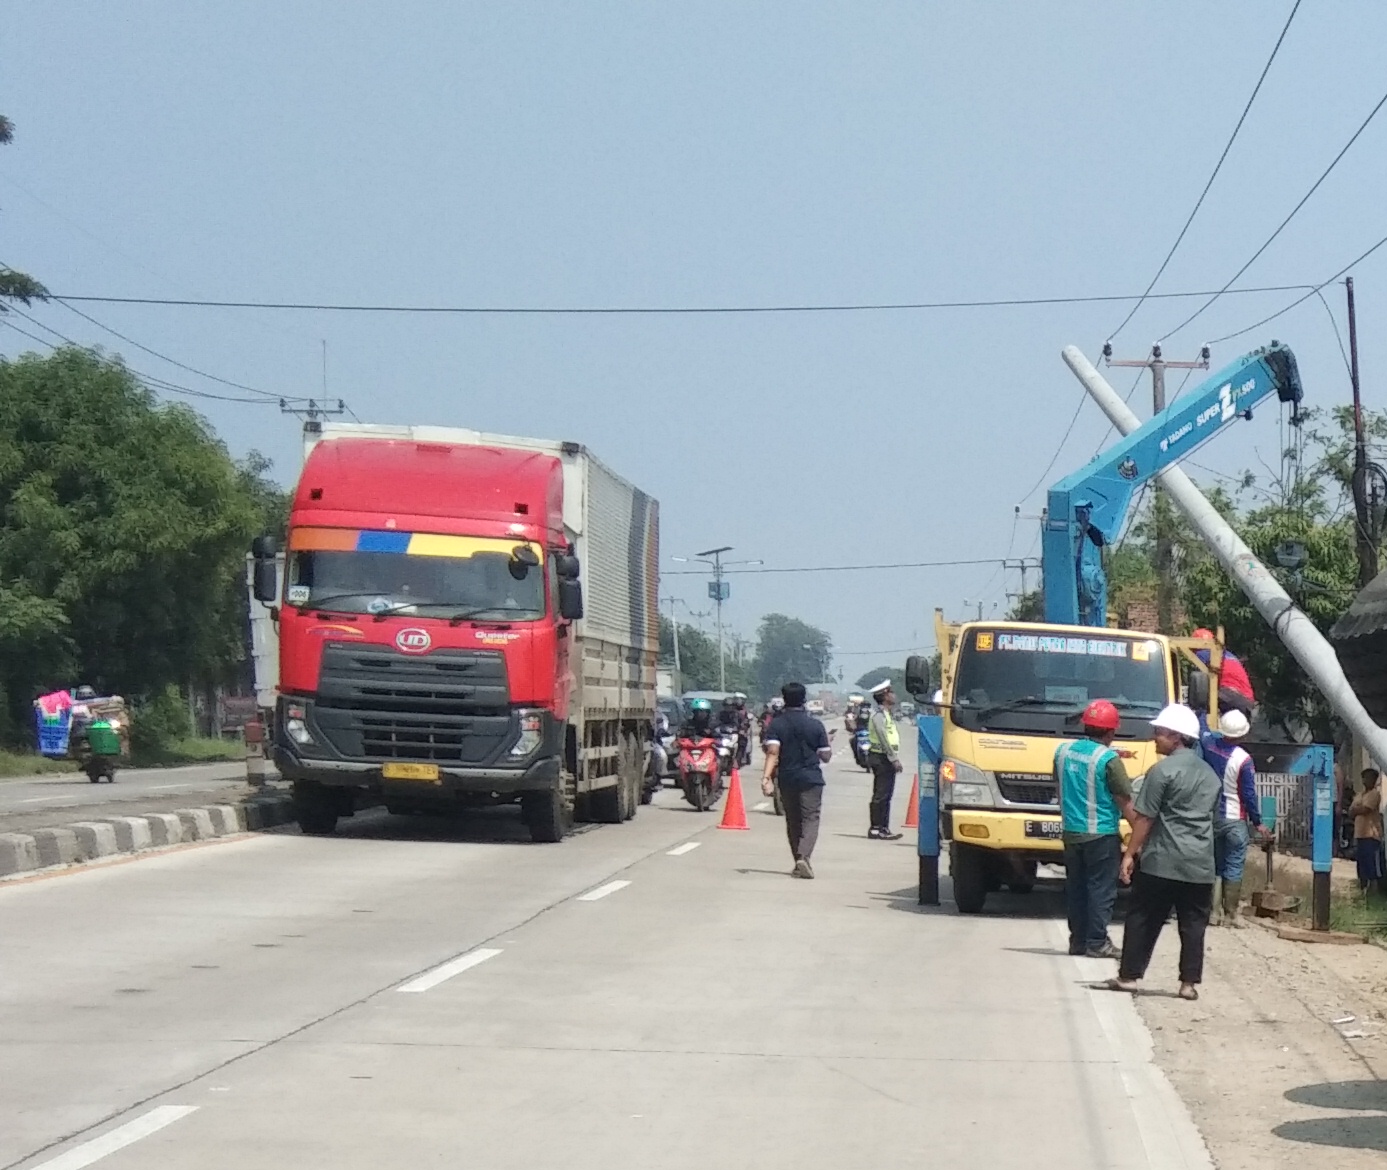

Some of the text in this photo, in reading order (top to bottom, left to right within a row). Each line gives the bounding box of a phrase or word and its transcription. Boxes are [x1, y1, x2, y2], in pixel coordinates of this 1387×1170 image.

[1196, 402, 1220, 427] SUPER
[399, 633, 428, 648] UD
[1026, 820, 1034, 833] E
